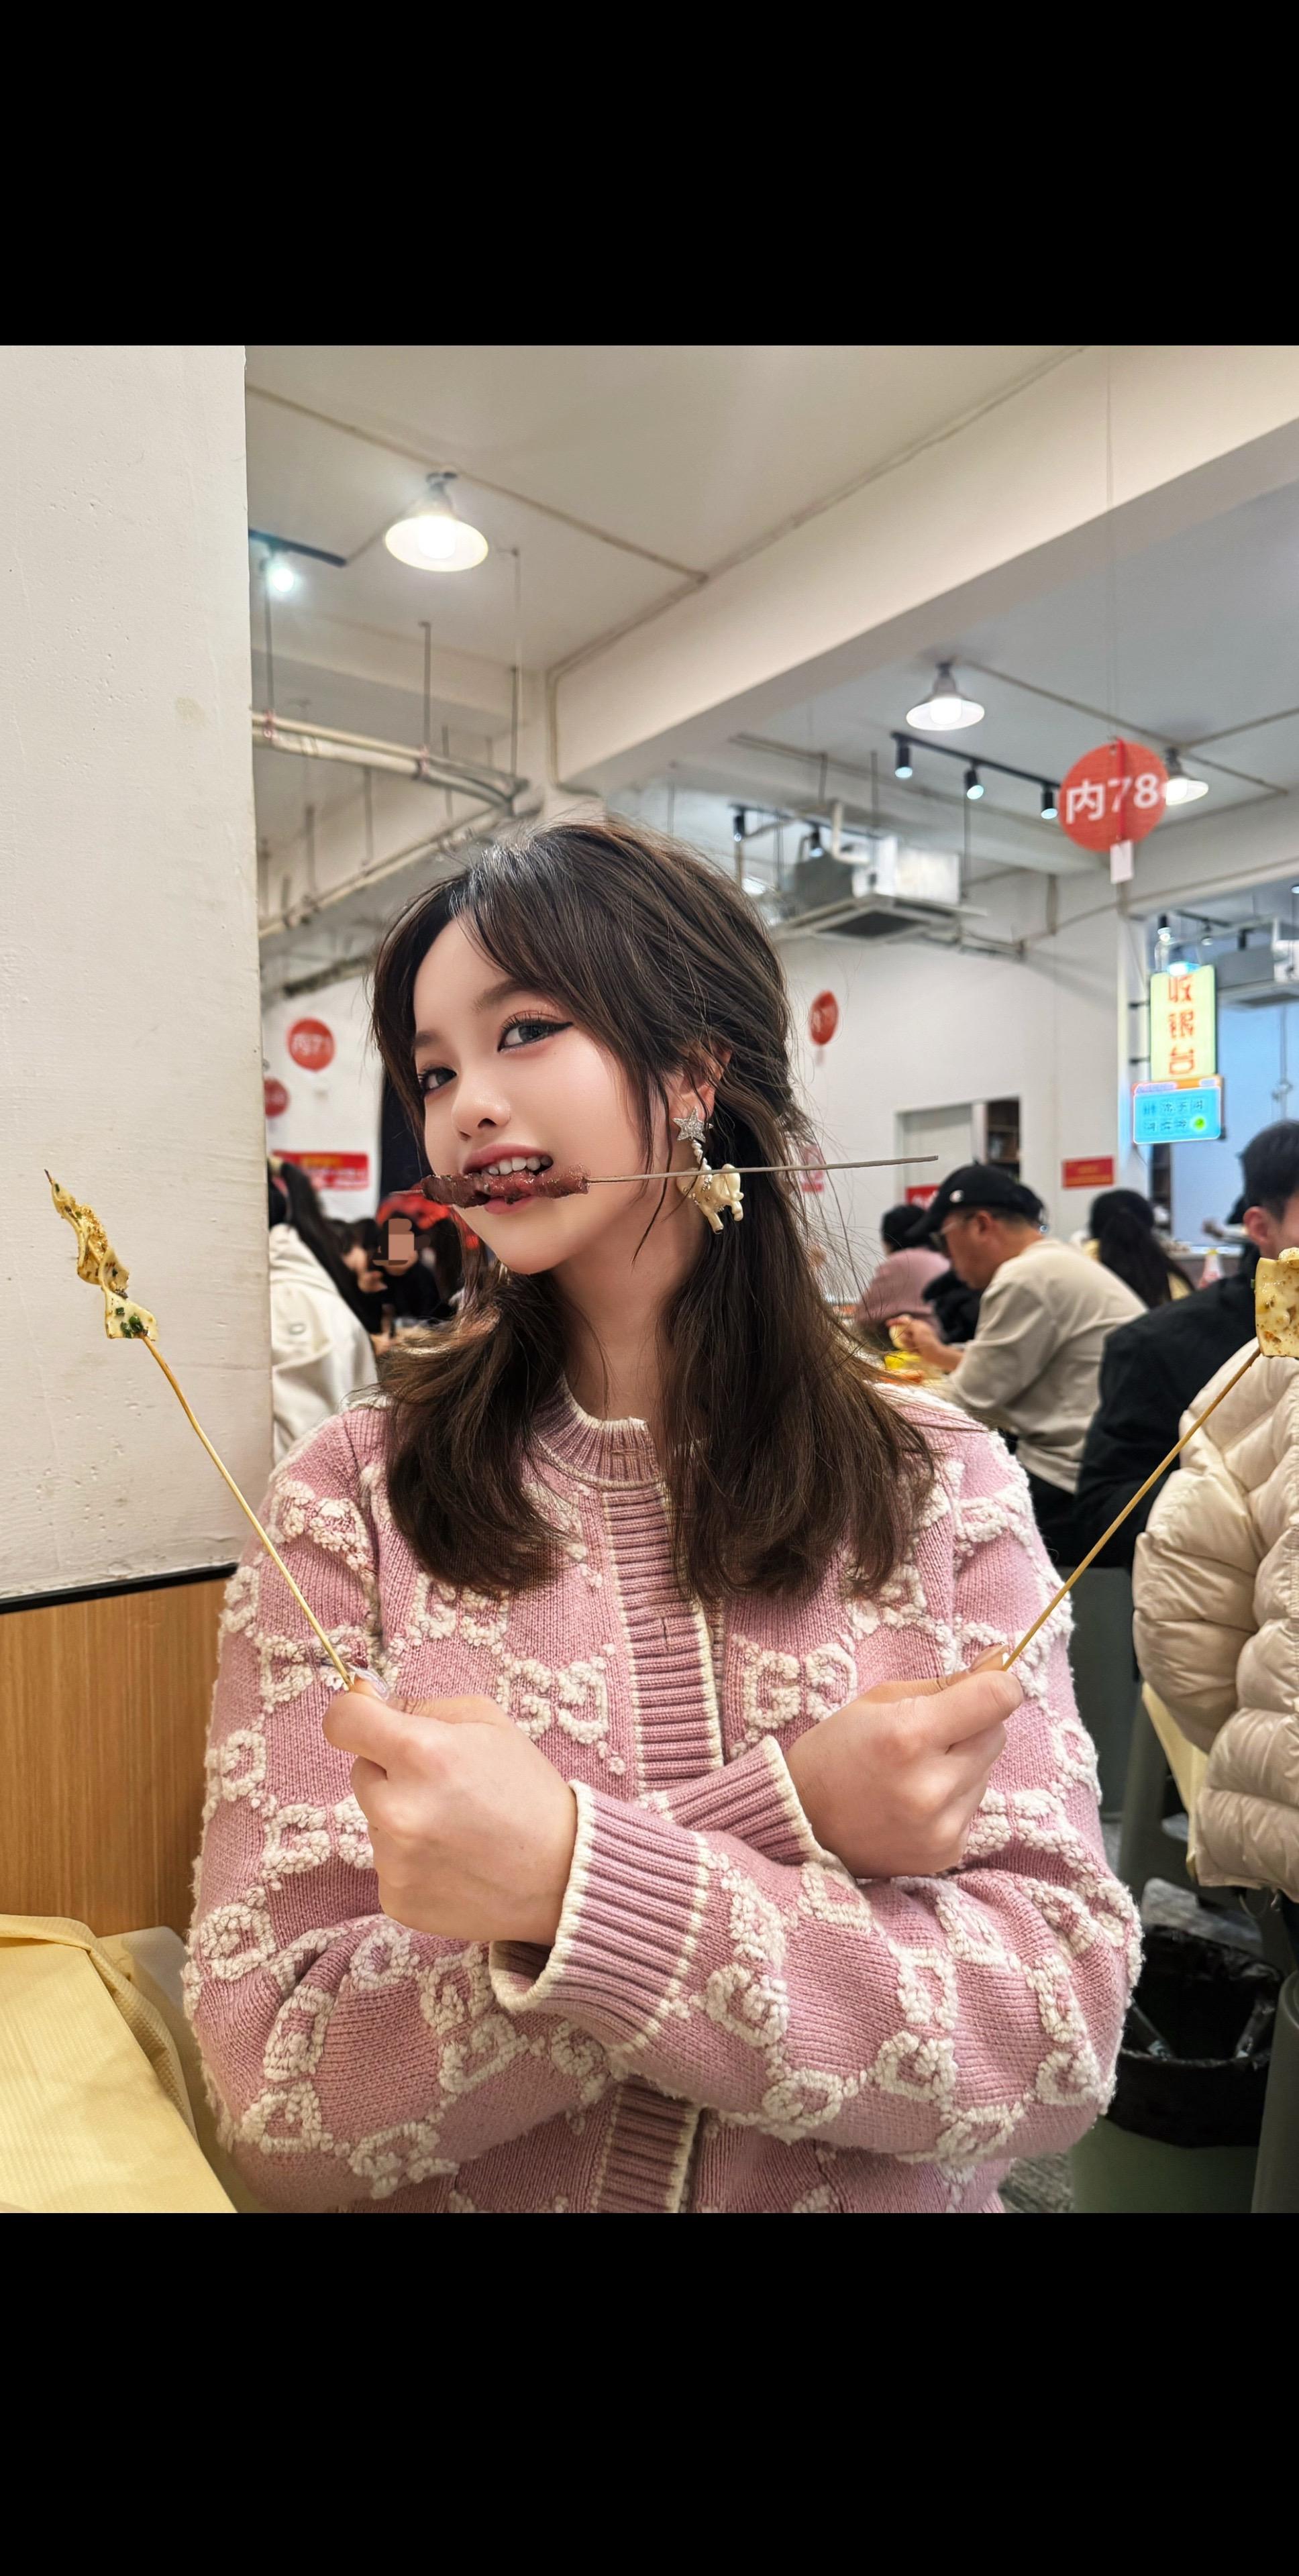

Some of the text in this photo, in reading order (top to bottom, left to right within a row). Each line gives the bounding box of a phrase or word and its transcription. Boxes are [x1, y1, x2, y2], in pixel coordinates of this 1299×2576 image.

[1066, 773, 1159, 824] 内78
[1167, 974, 1195, 1075] 收银台
